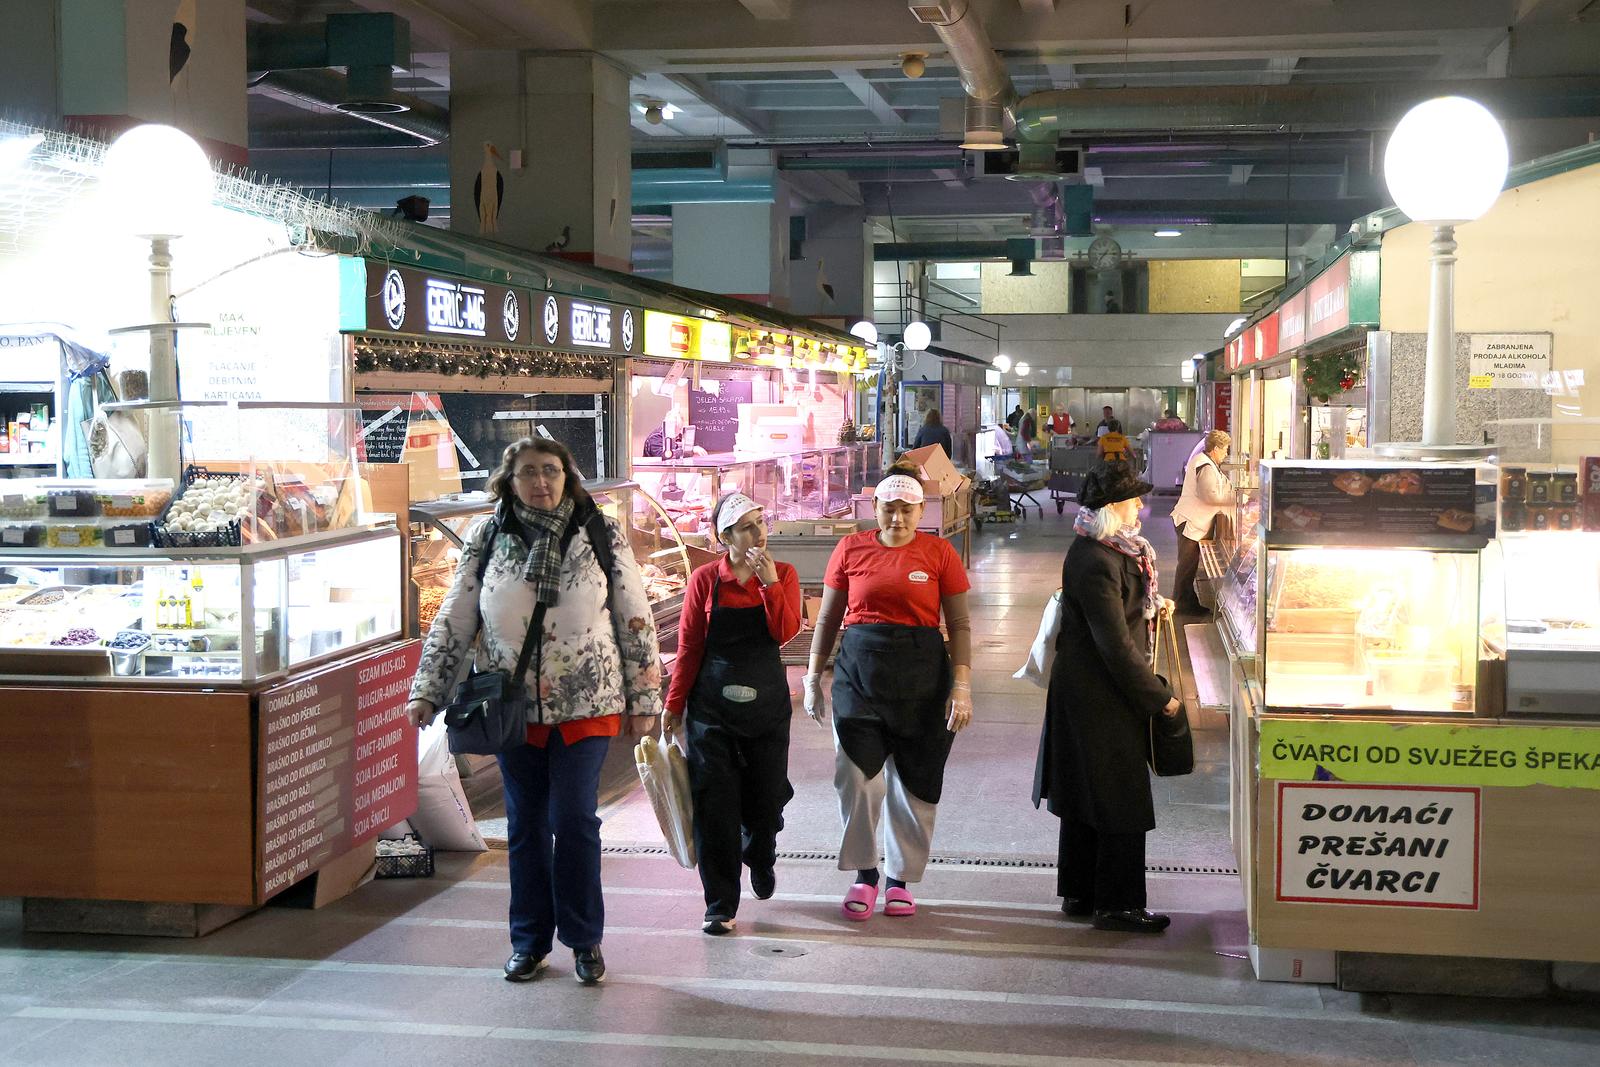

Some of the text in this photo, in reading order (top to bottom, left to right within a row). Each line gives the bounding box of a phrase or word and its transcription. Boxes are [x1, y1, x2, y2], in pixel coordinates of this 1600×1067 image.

[204, 391, 262, 400] KARTICAMA
[358, 655, 406, 685] SEZAM KUS-KUS
[296, 684, 318, 703] BRAŠNA
[268, 704, 321, 734] BRAŠNO OD PŠENICE
[267, 724, 317, 754] BRAŠNO OD JEČMA
[267, 755, 290, 774] BRAŠNO
[290, 751, 299, 764] OD
[305, 736, 332, 757] KUKURUZA
[1272, 738, 1358, 763] ČVARCI
[1366, 746, 1400, 764] OD
[1408, 745, 1517, 769] SVJEŽEG
[266, 757, 327, 794] BRAŠNO OD KUKURUZA
[355, 753, 399, 787] SOJA LJUSKICE
[266, 794, 289, 815] BRAŠNO
[289, 789, 298, 803] OD
[354, 774, 406, 813] SOJA MEDALJONI
[265, 799, 315, 834] BRAŠNO OD PROSA
[354, 805, 390, 838] SOJA ŠNICLI
[1301, 802, 1453, 825] DOMAĆI
[265, 817, 316, 854] BRAŠNO OD HELJDE
[1298, 831, 1449, 859] PREŠANI
[265, 853, 287, 874] BRAŠNO
[287, 847, 297, 861] OD
[301, 832, 323, 854] ŽITARICA
[265, 871, 287, 893] BRAŠNO
[296, 858, 309, 875] PIRA
[1306, 862, 1441, 894] ČVARCI
